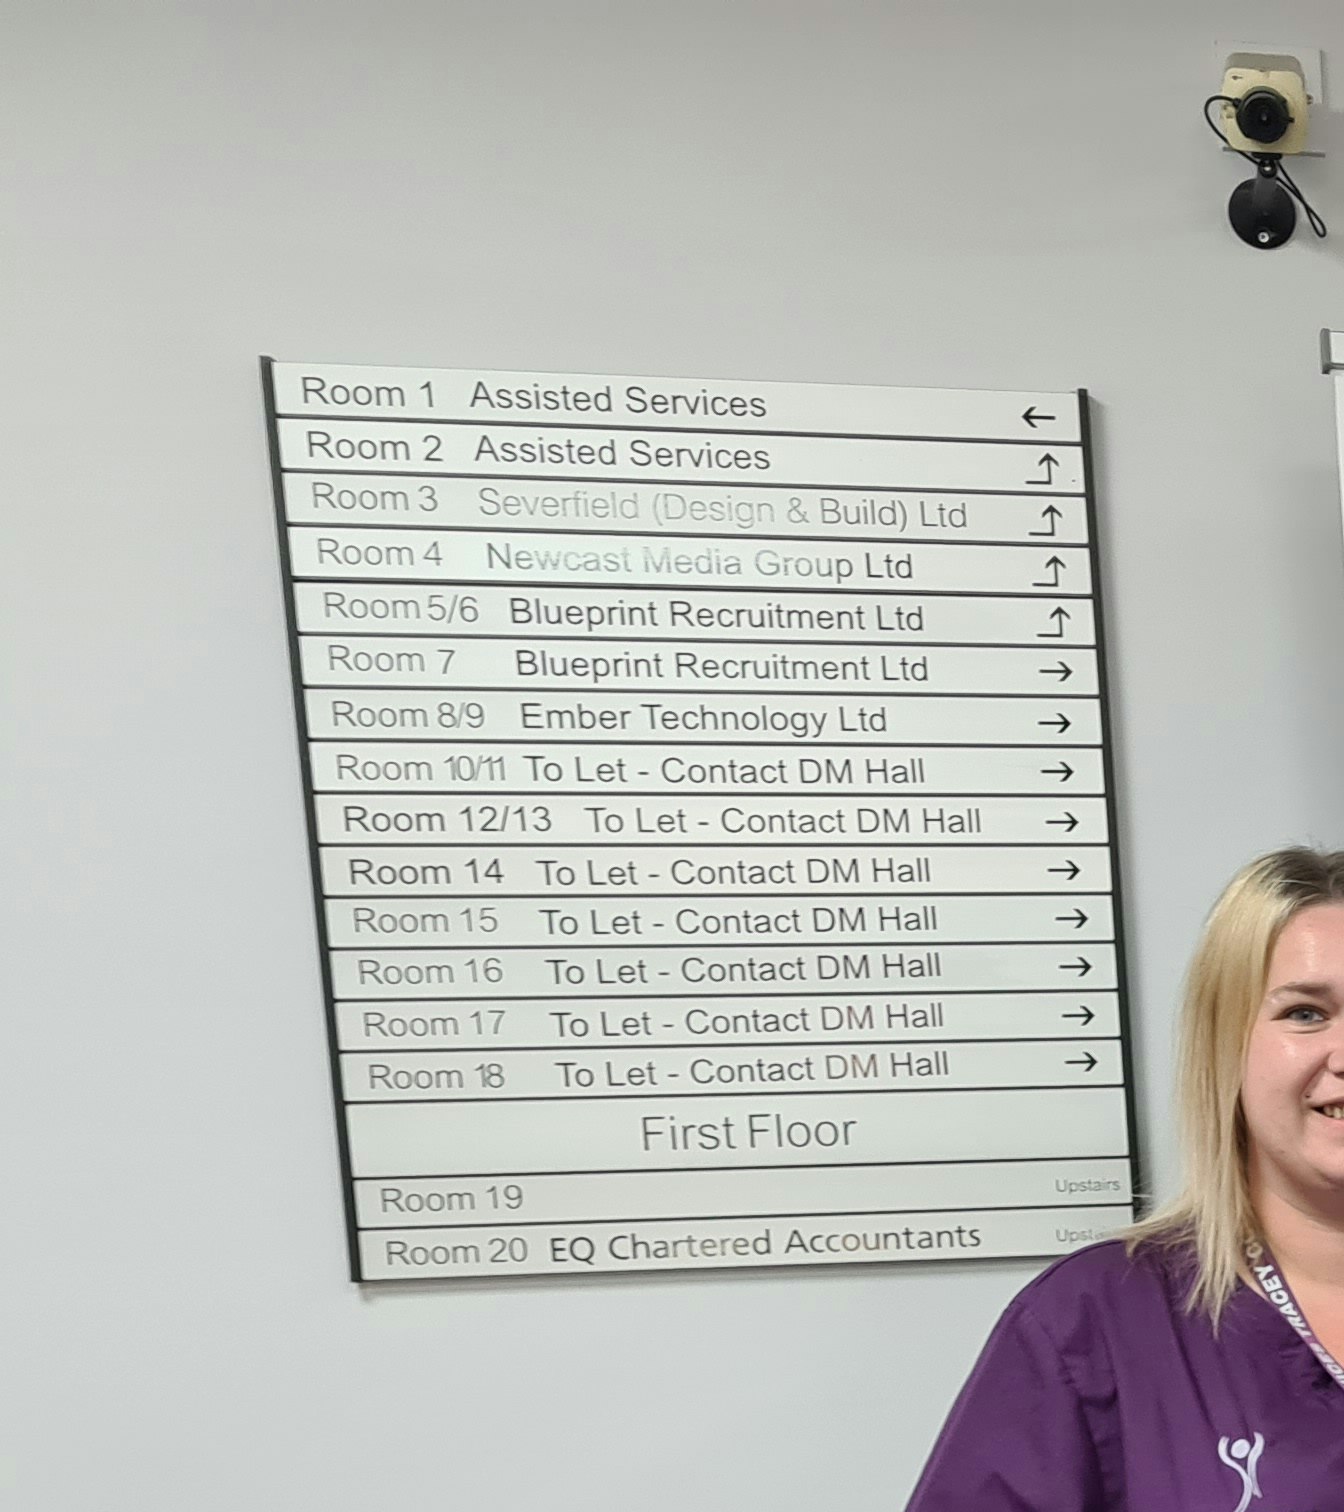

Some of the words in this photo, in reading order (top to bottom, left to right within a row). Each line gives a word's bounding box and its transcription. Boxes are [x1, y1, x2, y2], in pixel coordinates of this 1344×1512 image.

[302, 377, 405, 406] Room
[420, 381, 433, 407] 1
[470, 381, 612, 412] Assisted
[626, 387, 766, 417] Services
[307, 431, 410, 460] Room
[423, 435, 443, 461] 2
[475, 435, 616, 465] Assisted
[630, 440, 770, 469] Services
[312, 482, 409, 510] Room
[418, 486, 438, 511] 3
[479, 488, 638, 519] Severfield
[653, 493, 774, 529] (Design
[787, 497, 810, 523] &
[821, 498, 907, 532] Build)
[920, 501, 967, 528] Ltd
[318, 538, 414, 565] Room
[423, 541, 442, 566] 4
[487, 543, 632, 572] Newcast
[643, 547, 742, 575] Media
[756, 550, 853, 584] Group
[866, 553, 912, 578] Ltd
[324, 592, 420, 618] Room
[428, 595, 478, 623] 5/6
[510, 598, 658, 631] Blueprint
[670, 601, 865, 630] Recruitment
[877, 605, 923, 631] Ltd
[328, 645, 424, 672] Room
[437, 649, 455, 674] 7
[516, 650, 663, 683] Blueprint
[676, 653, 870, 680] Recruitment
[881, 656, 928, 681] Ltd
[332, 701, 428, 727] Room
[438, 702, 484, 728] 8/9
[521, 703, 631, 729] Ember
[640, 704, 827, 738] Technology
[839, 707, 886, 732] Ltd
[337, 754, 432, 780] Room
[444, 756, 505, 781] 10/11
[523, 756, 562, 781] To
[575, 757, 627, 782] Let
[662, 758, 788, 783] Contact
[800, 759, 852, 783] DM
[866, 758, 924, 783] Hall
[344, 806, 445, 832] Room
[460, 806, 551, 831] 12/13
[584, 808, 623, 832] To
[637, 808, 687, 833] Let
[722, 808, 846, 833] Contact
[858, 809, 909, 833] DM
[923, 808, 980, 833] Hall
[349, 859, 450, 884] Room
[465, 859, 504, 883] 14
[535, 861, 575, 885] To
[588, 860, 638, 885] Let
[671, 860, 796, 885] Contact
[807, 859, 859, 883] DM
[872, 858, 930, 882] Hall
[354, 908, 448, 933] Room
[460, 908, 497, 932] 15
[539, 910, 578, 935] To
[591, 910, 642, 934] Let
[676, 909, 802, 934] Contact
[813, 907, 865, 932] DM
[879, 906, 937, 931] Hall
[358, 960, 454, 984] Room
[465, 958, 502, 982] 16
[545, 960, 584, 984] To
[597, 959, 648, 984] Let
[682, 957, 806, 982] Contact
[818, 955, 870, 979] DM
[883, 953, 940, 978] Hall
[364, 1012, 458, 1037] Room
[470, 1010, 505, 1034] 17
[549, 1012, 588, 1037] To
[601, 1012, 651, 1036] Let
[686, 1008, 810, 1034] Contact
[821, 1005, 874, 1030] DM
[886, 1003, 943, 1028] Hall
[369, 1064, 463, 1089] Room
[475, 1064, 504, 1088] 18
[555, 1063, 594, 1087] To
[606, 1062, 657, 1086] Let
[691, 1058, 815, 1084] Contact
[826, 1054, 878, 1079] DM
[891, 1051, 948, 1077] Hall
[642, 1116, 736, 1150] First
[749, 1114, 857, 1148] Floor
[381, 1188, 475, 1212] Room
[487, 1185, 522, 1209] 19
[1056, 1180, 1121, 1194] Upstairs
[386, 1241, 480, 1265] Room
[489, 1237, 527, 1262] 20
[551, 1237, 594, 1265] EQ
[609, 1229, 771, 1260] Chartered
[785, 1226, 980, 1253] Accountants
[1252, 1264, 1312, 1337] TRACEY
